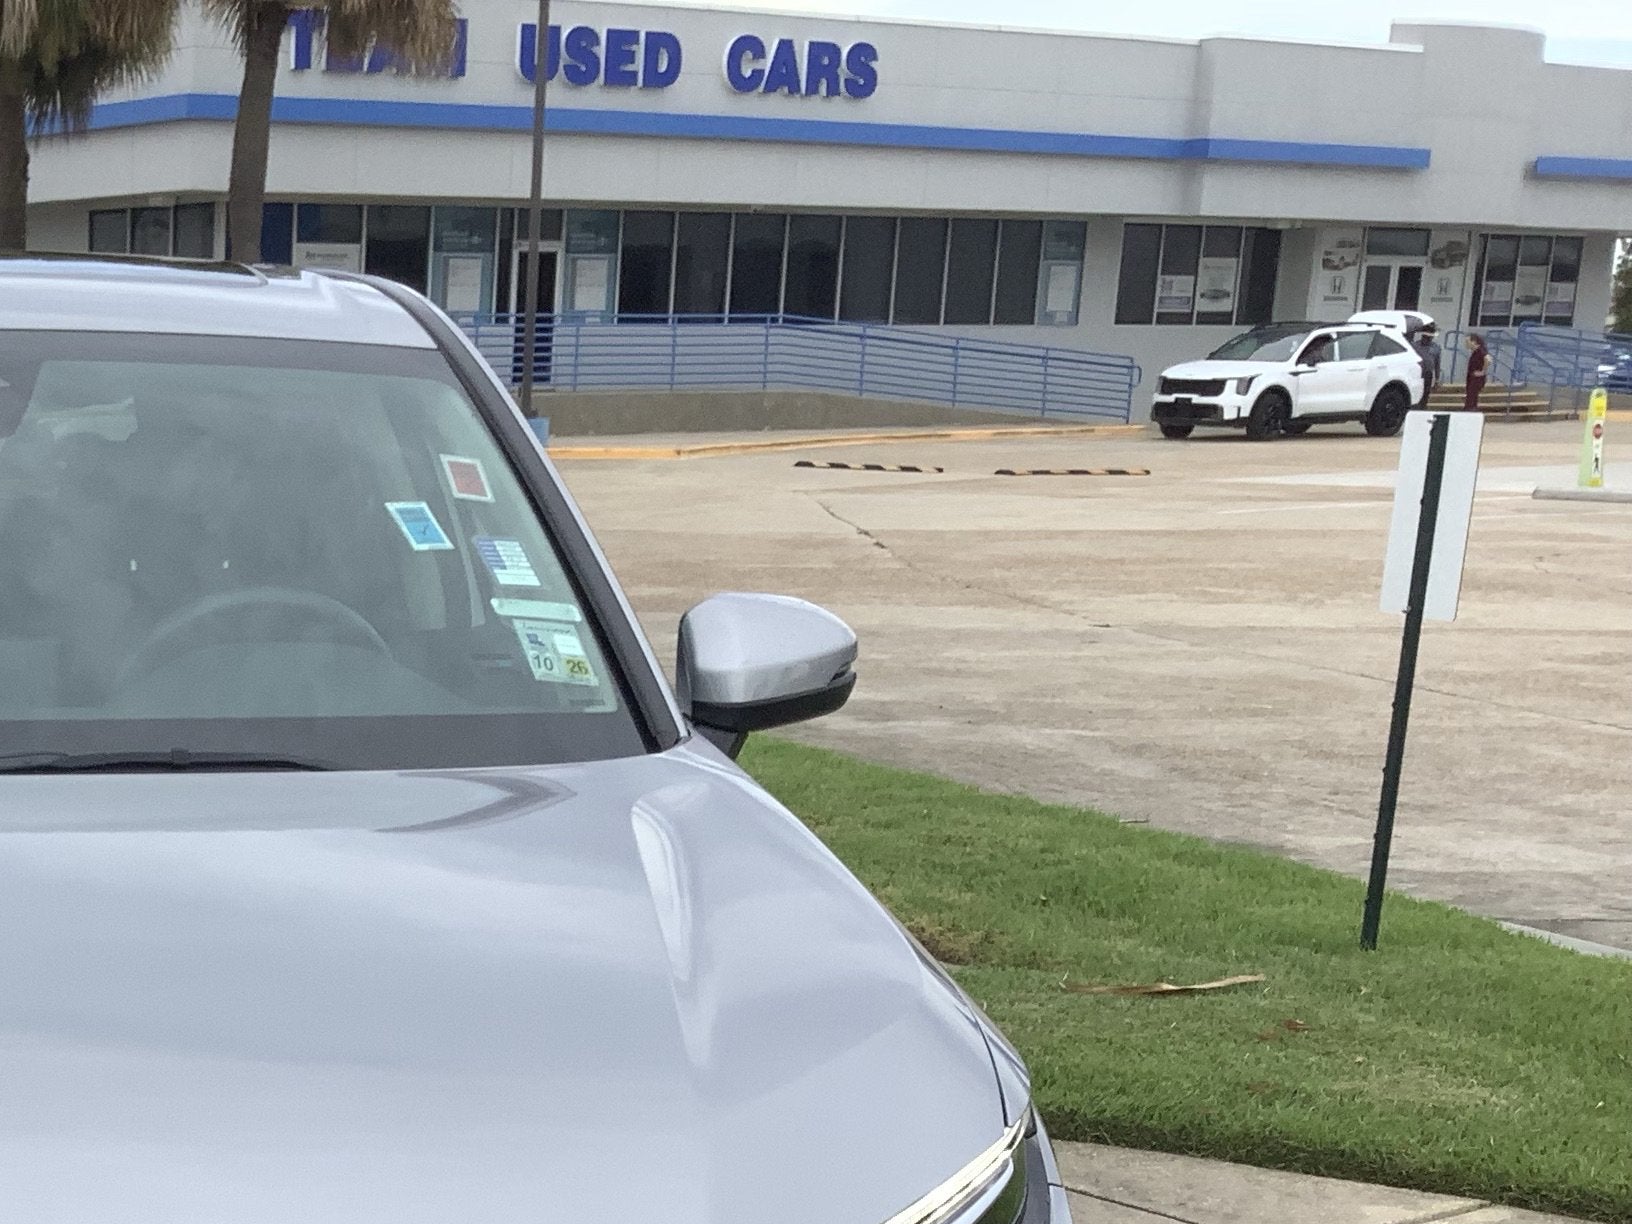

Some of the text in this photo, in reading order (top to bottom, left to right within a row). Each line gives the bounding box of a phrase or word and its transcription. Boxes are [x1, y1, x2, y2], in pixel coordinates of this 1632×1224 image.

[518, 23, 683, 89] USED
[725, 34, 880, 99] CARS
[533, 654, 589, 675] 10 26
